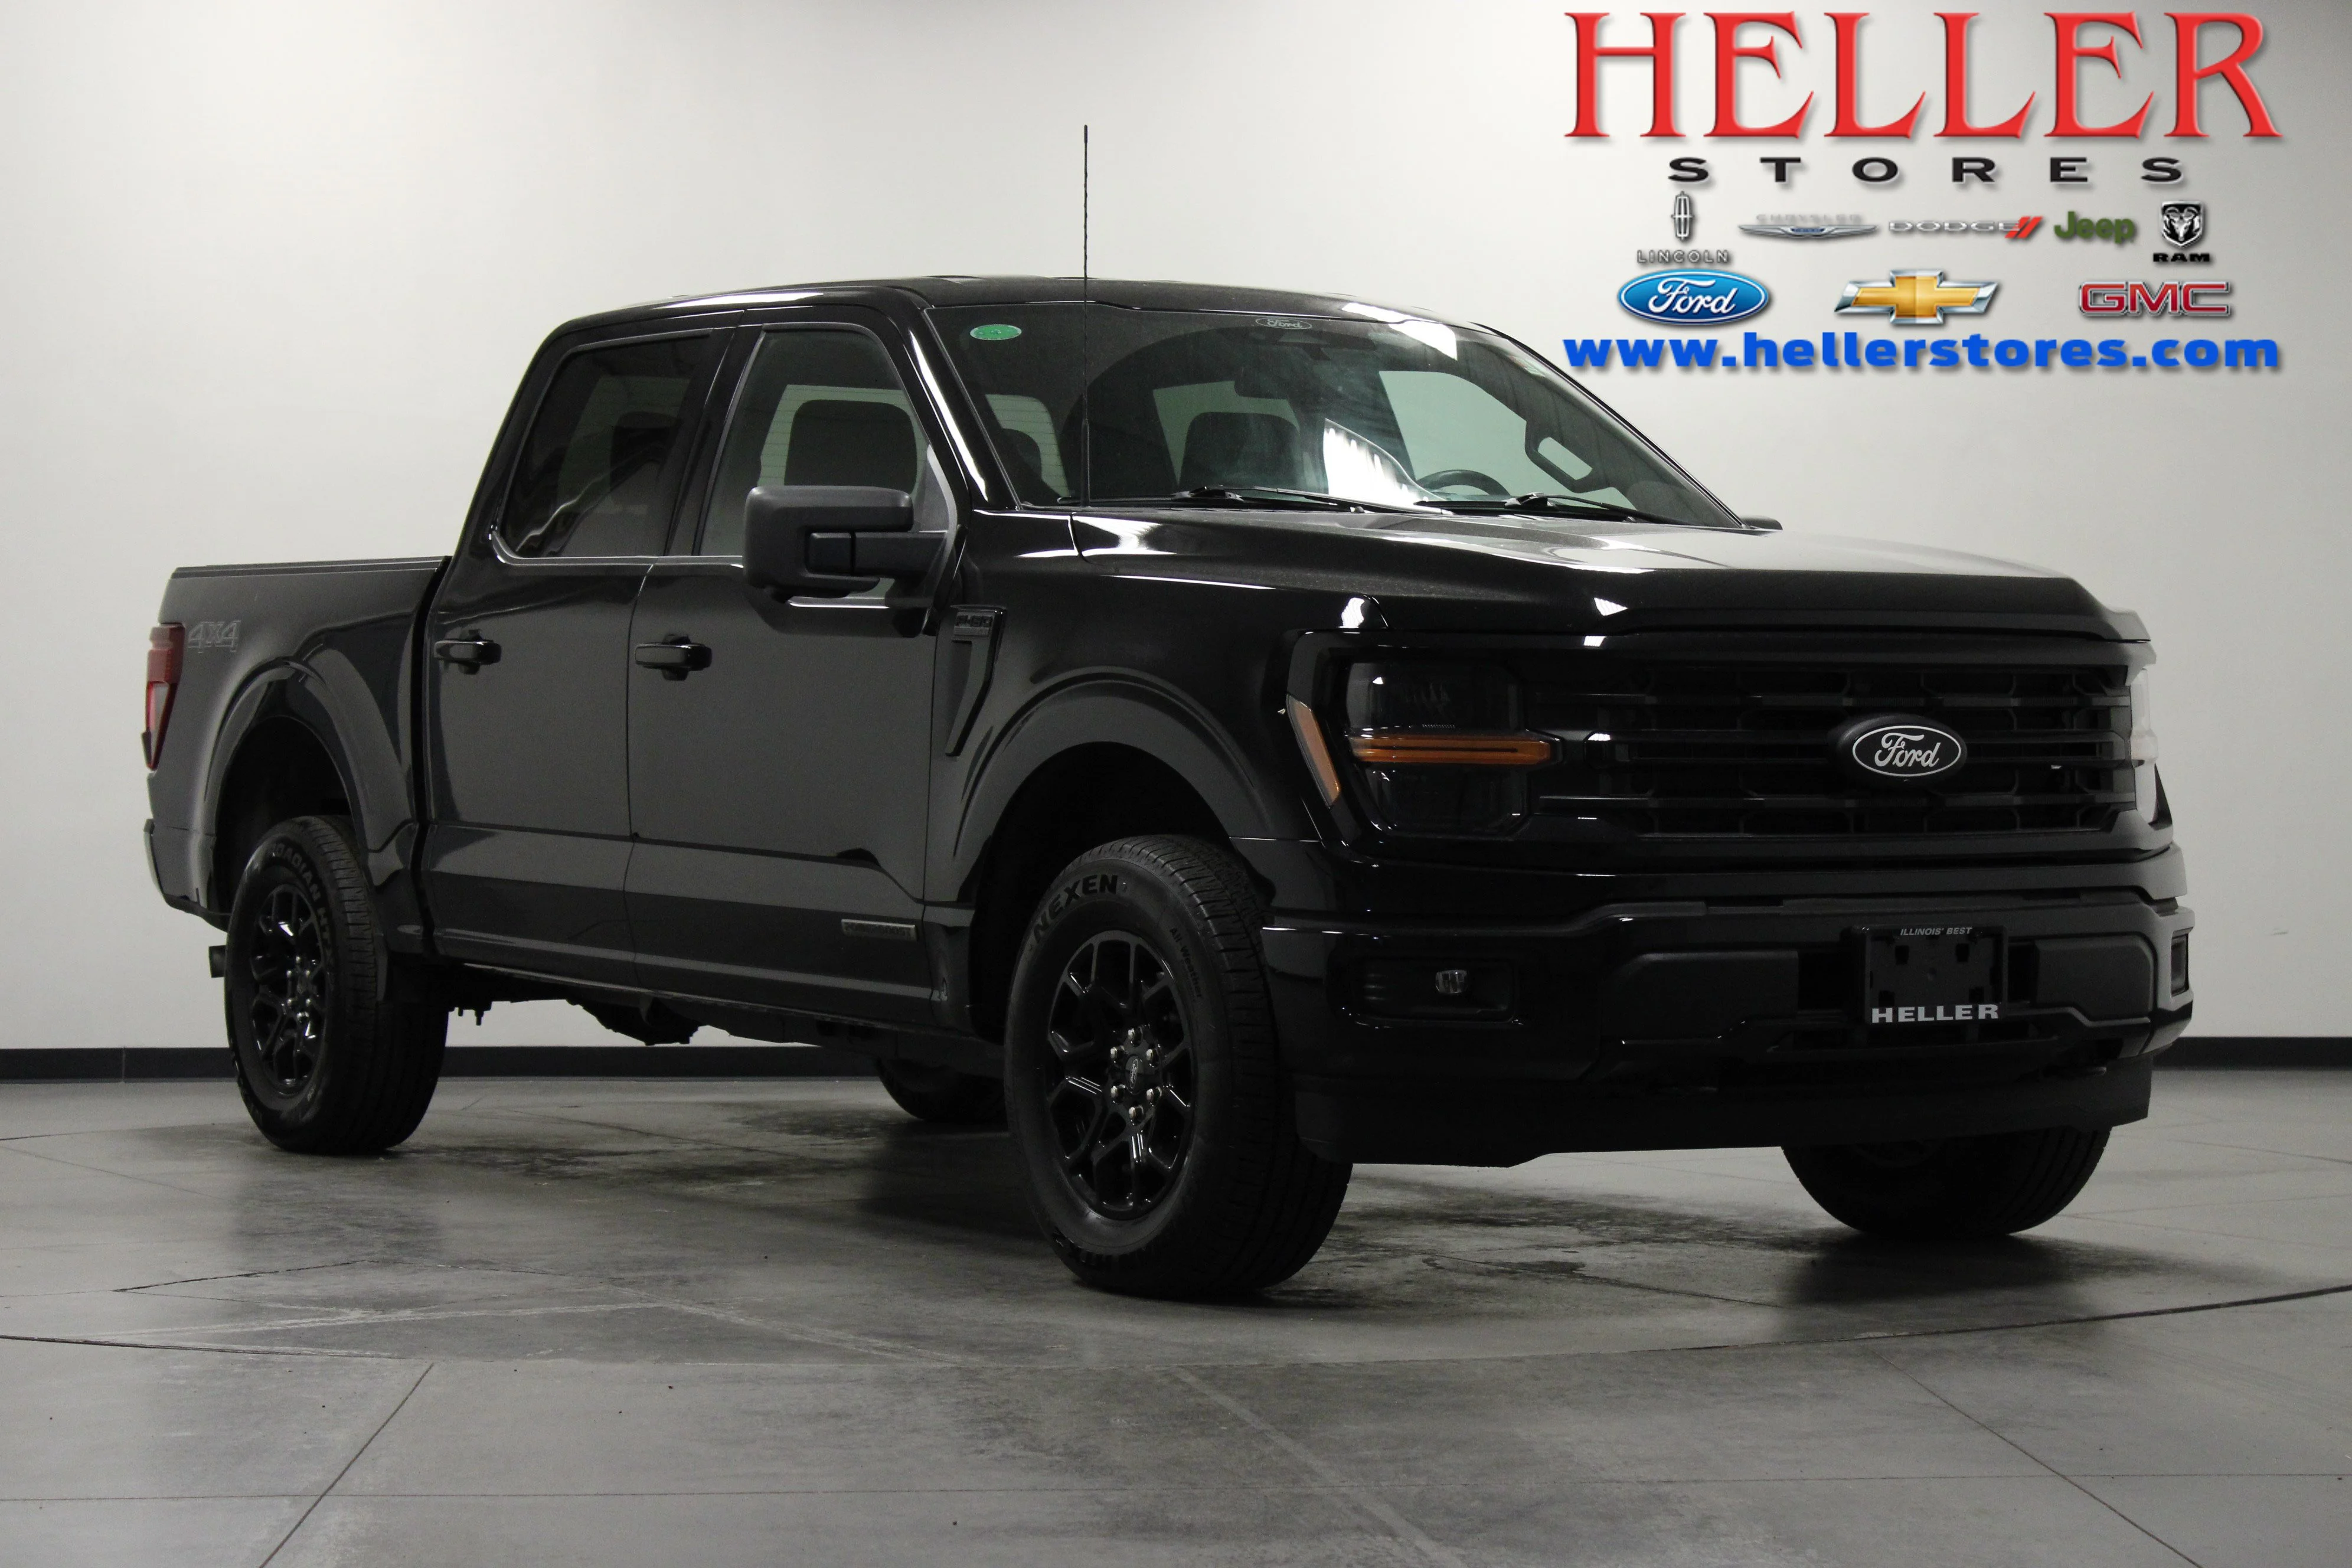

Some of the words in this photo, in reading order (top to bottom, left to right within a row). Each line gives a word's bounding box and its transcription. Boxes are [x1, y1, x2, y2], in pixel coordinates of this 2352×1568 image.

[1266, 318, 1304, 328] Ford
[1874, 731, 1941, 767] Ford
[1033, 874, 1119, 943] NEXEN
[1871, 1004, 1999, 1023] HELLER
